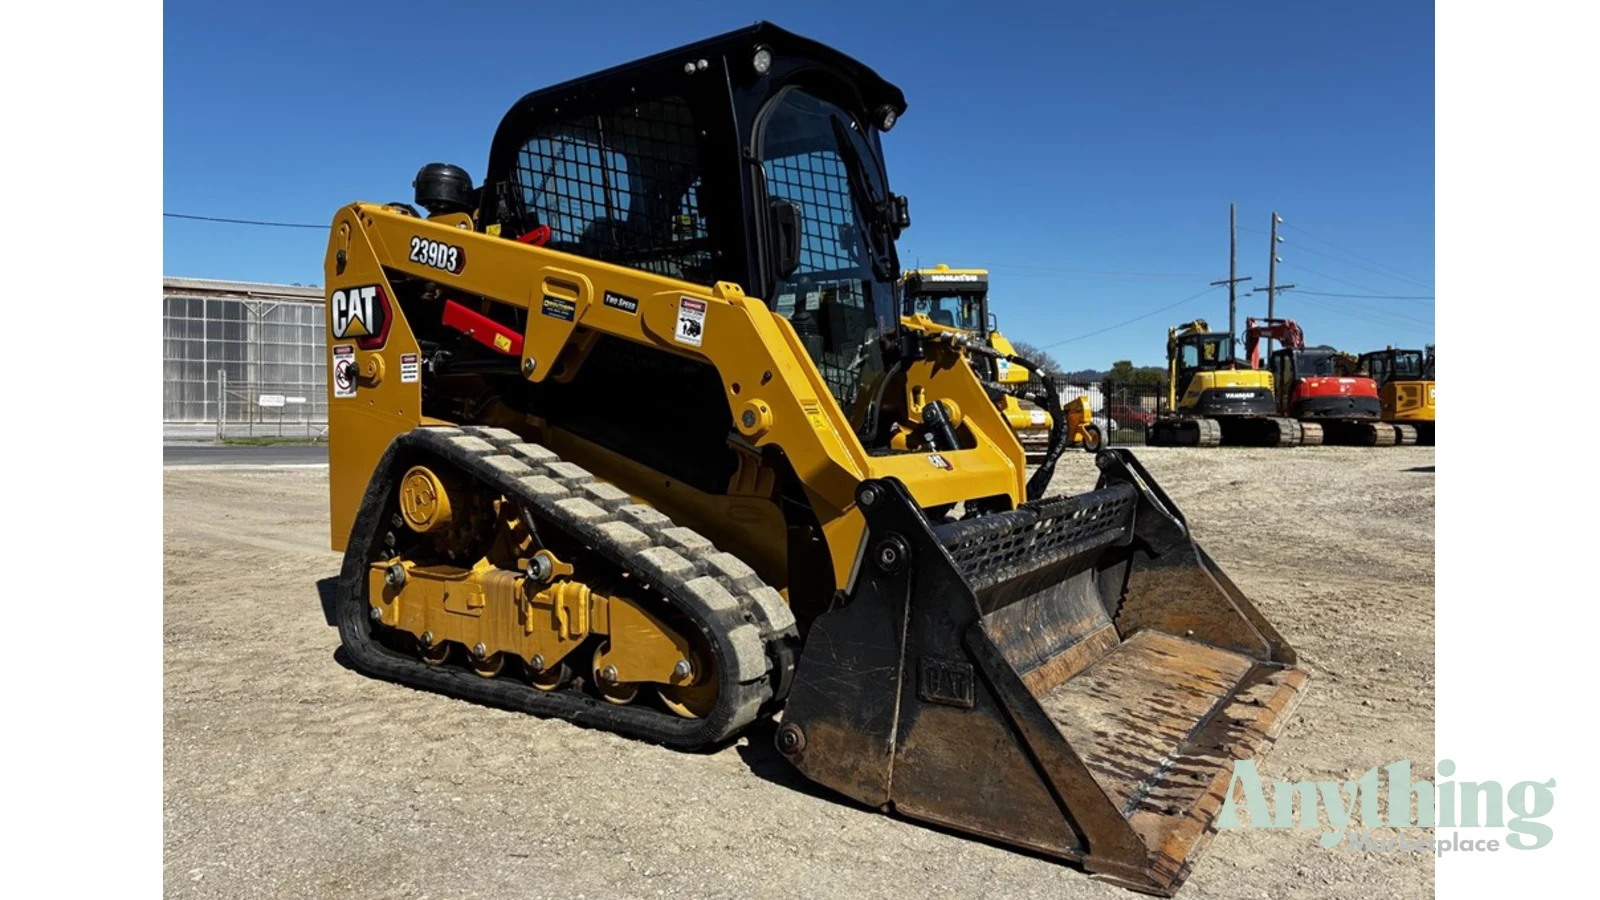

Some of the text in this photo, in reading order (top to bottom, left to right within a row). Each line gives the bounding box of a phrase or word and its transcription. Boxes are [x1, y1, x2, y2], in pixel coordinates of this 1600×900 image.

[410, 237, 458, 271] 239D3
[931, 274, 978, 282] KOMATSU
[332, 286, 376, 338] CAT
[925, 666, 967, 700] CAT
